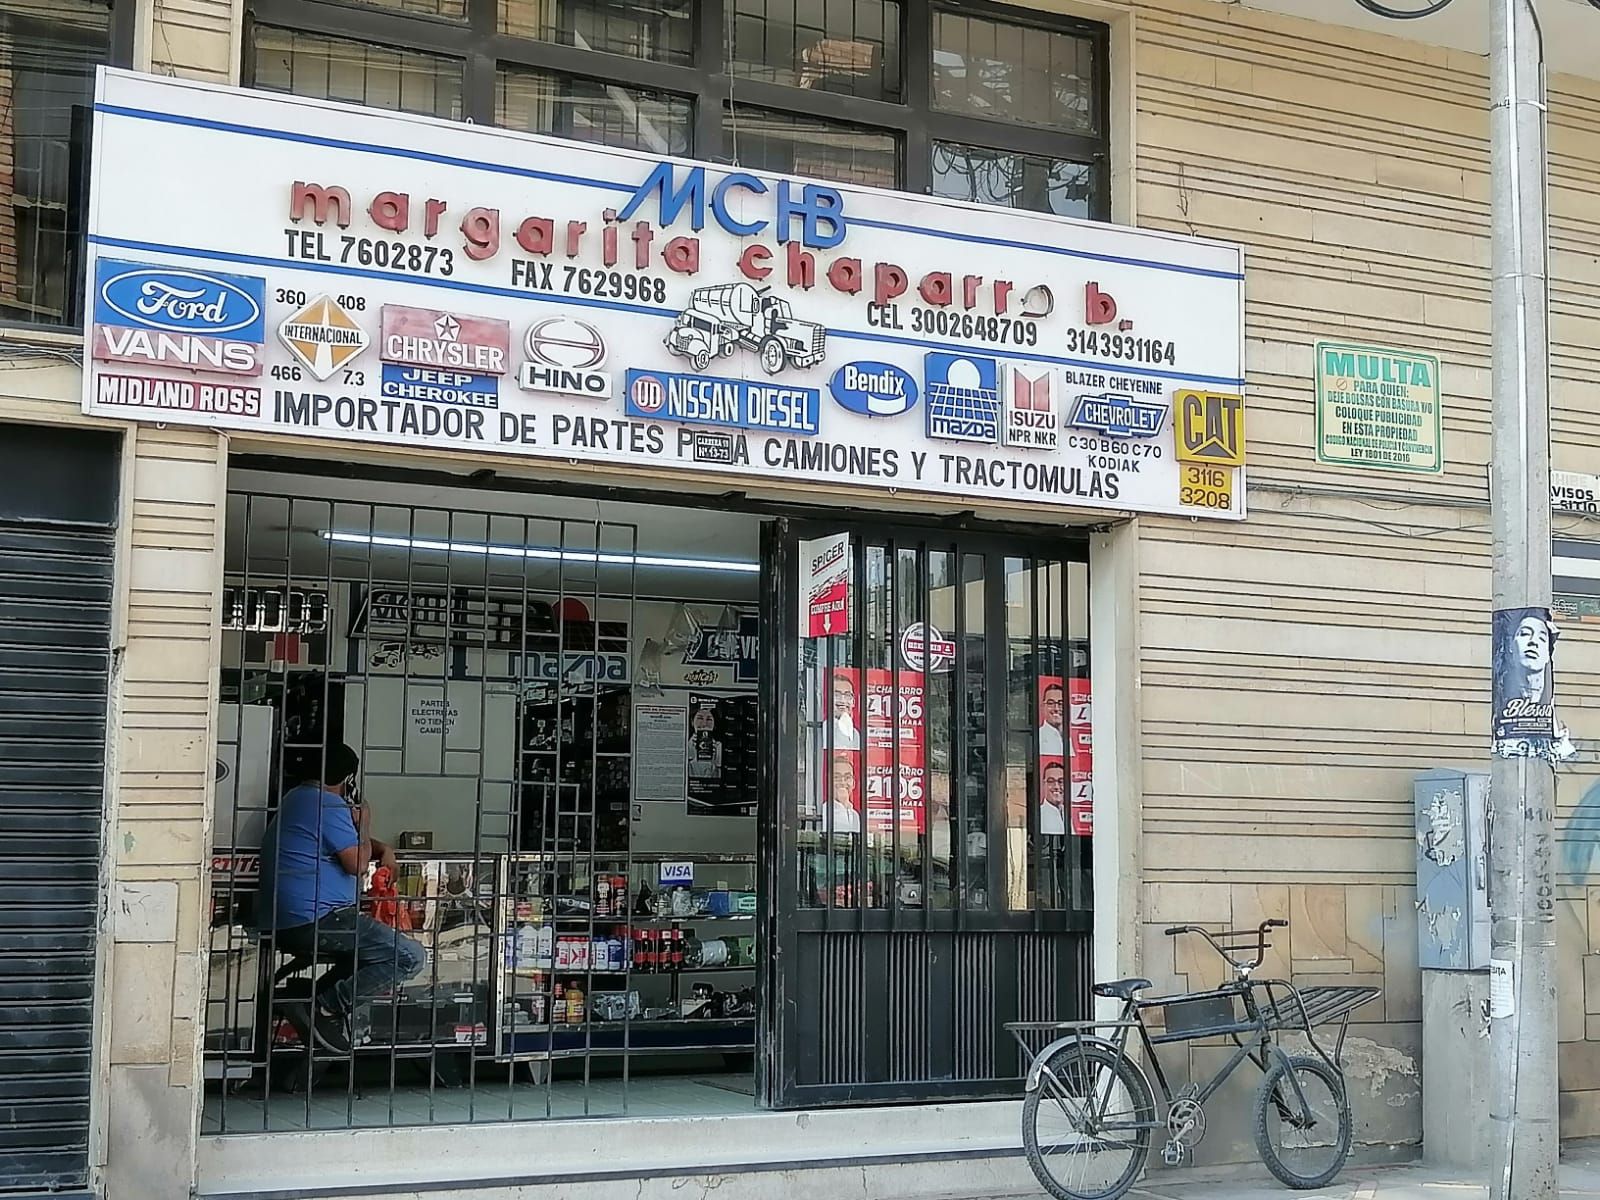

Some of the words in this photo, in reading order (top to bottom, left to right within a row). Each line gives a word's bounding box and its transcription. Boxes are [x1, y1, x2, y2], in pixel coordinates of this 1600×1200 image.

[616, 161, 847, 249] MCHB
[284, 229, 331, 261] TEL
[340, 236, 454, 276] 7602873
[290, 180, 699, 275] margarita
[1085, 281, 1133, 331] b.
[512, 259, 553, 292] FAX
[563, 266, 666, 303] 7629968
[137, 281, 227, 323] Ford
[276, 289, 306, 306] 360
[337, 295, 366, 312] 408
[867, 301, 903, 331] CEL
[911, 307, 1038, 346] 3002648709
[284, 325, 363, 345] INTERNACIONAL
[102, 327, 255, 371] VANNS
[388, 334, 504, 371] CHRYSLER
[1067, 328, 1175, 365] 3143931164
[271, 365, 302, 382] 466
[402, 369, 472, 386] JEEP
[845, 365, 905, 396] Bendix
[1325, 351, 1431, 388] MULTA
[529, 369, 606, 393] HINO
[1066, 371, 1105, 389] BLAZER
[1109, 375, 1163, 395] CHEYENNE
[1353, 380, 1378, 394] PARA
[100, 376, 194, 411] MIDLAND
[200, 385, 260, 415] ROSS
[383, 381, 498, 407] CHEROKEE
[636, 379, 661, 408] UD
[667, 378, 738, 422] NISSAN
[748, 387, 815, 430] DIESEL
[1328, 391, 1344, 403] DEJE
[1346, 392, 1374, 407] BOLSAS
[1376, 395, 1390, 409] CON
[1392, 397, 1420, 412] BASURA
[1010, 411, 1056, 429] ISUZU
[1084, 400, 1157, 430] CHEVROLET
[1183, 394, 1240, 458] CAT
[1335, 406, 1373, 421] COLOQUE
[1375, 410, 1422, 426] PUBLICIDAD
[933, 419, 996, 439] mazda
[1009, 429, 1031, 443] NPR
[1035, 431, 1057, 446] NKR
[1342, 421, 1352, 434] EN
[1354, 422, 1373, 437] ESTA
[1375, 424, 1417, 441] PROPIEDAD
[274, 390, 484, 440] IMPORTADOR
[501, 412, 536, 444] DE
[553, 414, 664, 454] PARTES
[677, 427, 750, 466] PA
[764, 438, 899, 477] CAMIONES
[911, 451, 927, 480] Y
[939, 454, 1120, 500] TRACTOMULAS
[1351, 447, 1363, 457] LEY
[1383, 451, 1391, 460] DE
[1088, 455, 1140, 473] KODIAK
[1188, 467, 1224, 488] 3116
[1180, 488, 1230, 509] 3208
[1551, 485, 1594, 501] VISOS
[812, 541, 844, 572] SPICER
[876, 685, 923, 695] CHAARRO
[876, 766, 924, 776] CHAARRO
[664, 864, 692, 878] VISA
